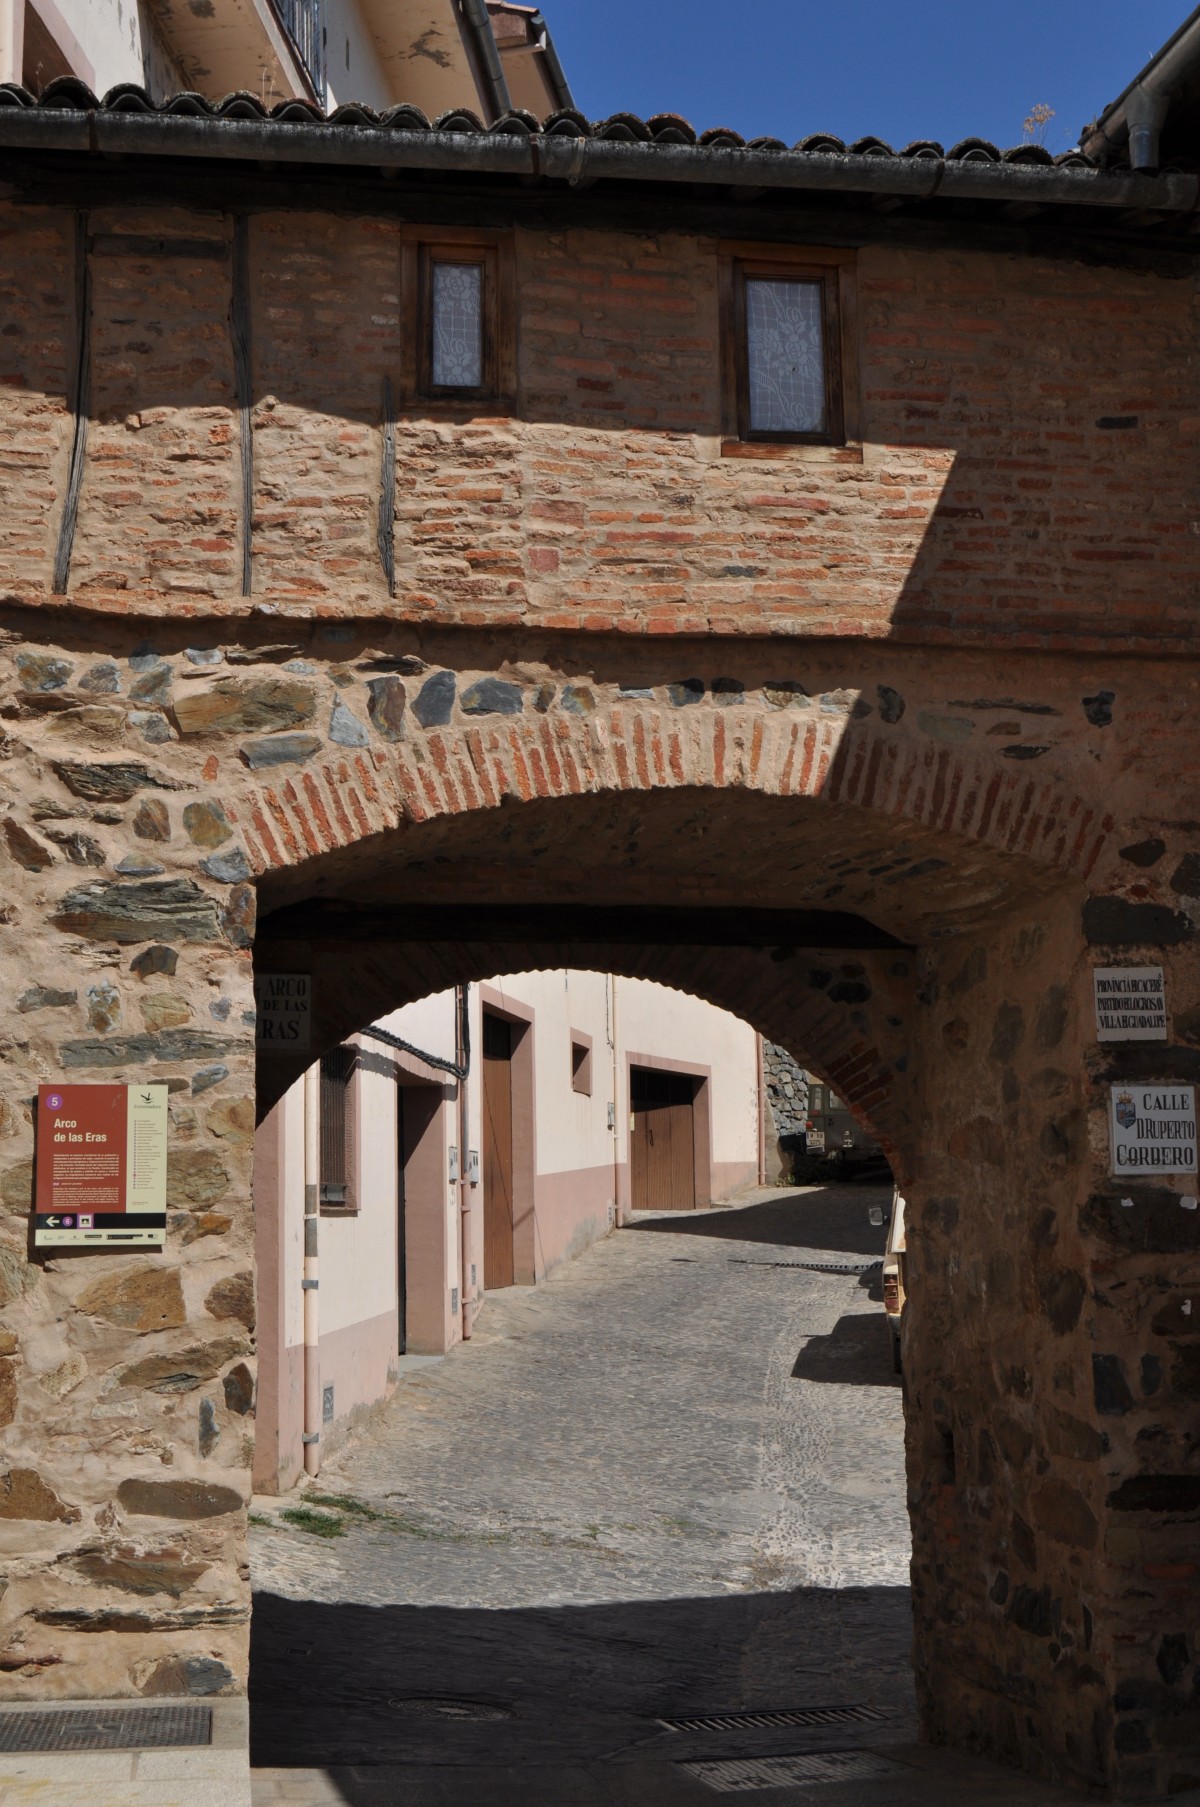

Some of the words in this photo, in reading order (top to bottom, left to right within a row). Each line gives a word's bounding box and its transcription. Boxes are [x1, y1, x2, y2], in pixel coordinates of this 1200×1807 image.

[268, 977, 306, 997] ARCO
[262, 999, 280, 1011] DE
[284, 999, 308, 1012] LAS
[51, 1097, 59, 1107] 5
[1143, 1093, 1190, 1111] CALLE
[53, 1118, 77, 1129] Arco
[53, 1132, 66, 1143] de
[68, 1132, 83, 1143] las
[85, 1132, 107, 1143] Eras
[1116, 1144, 1194, 1167] CORDERO
